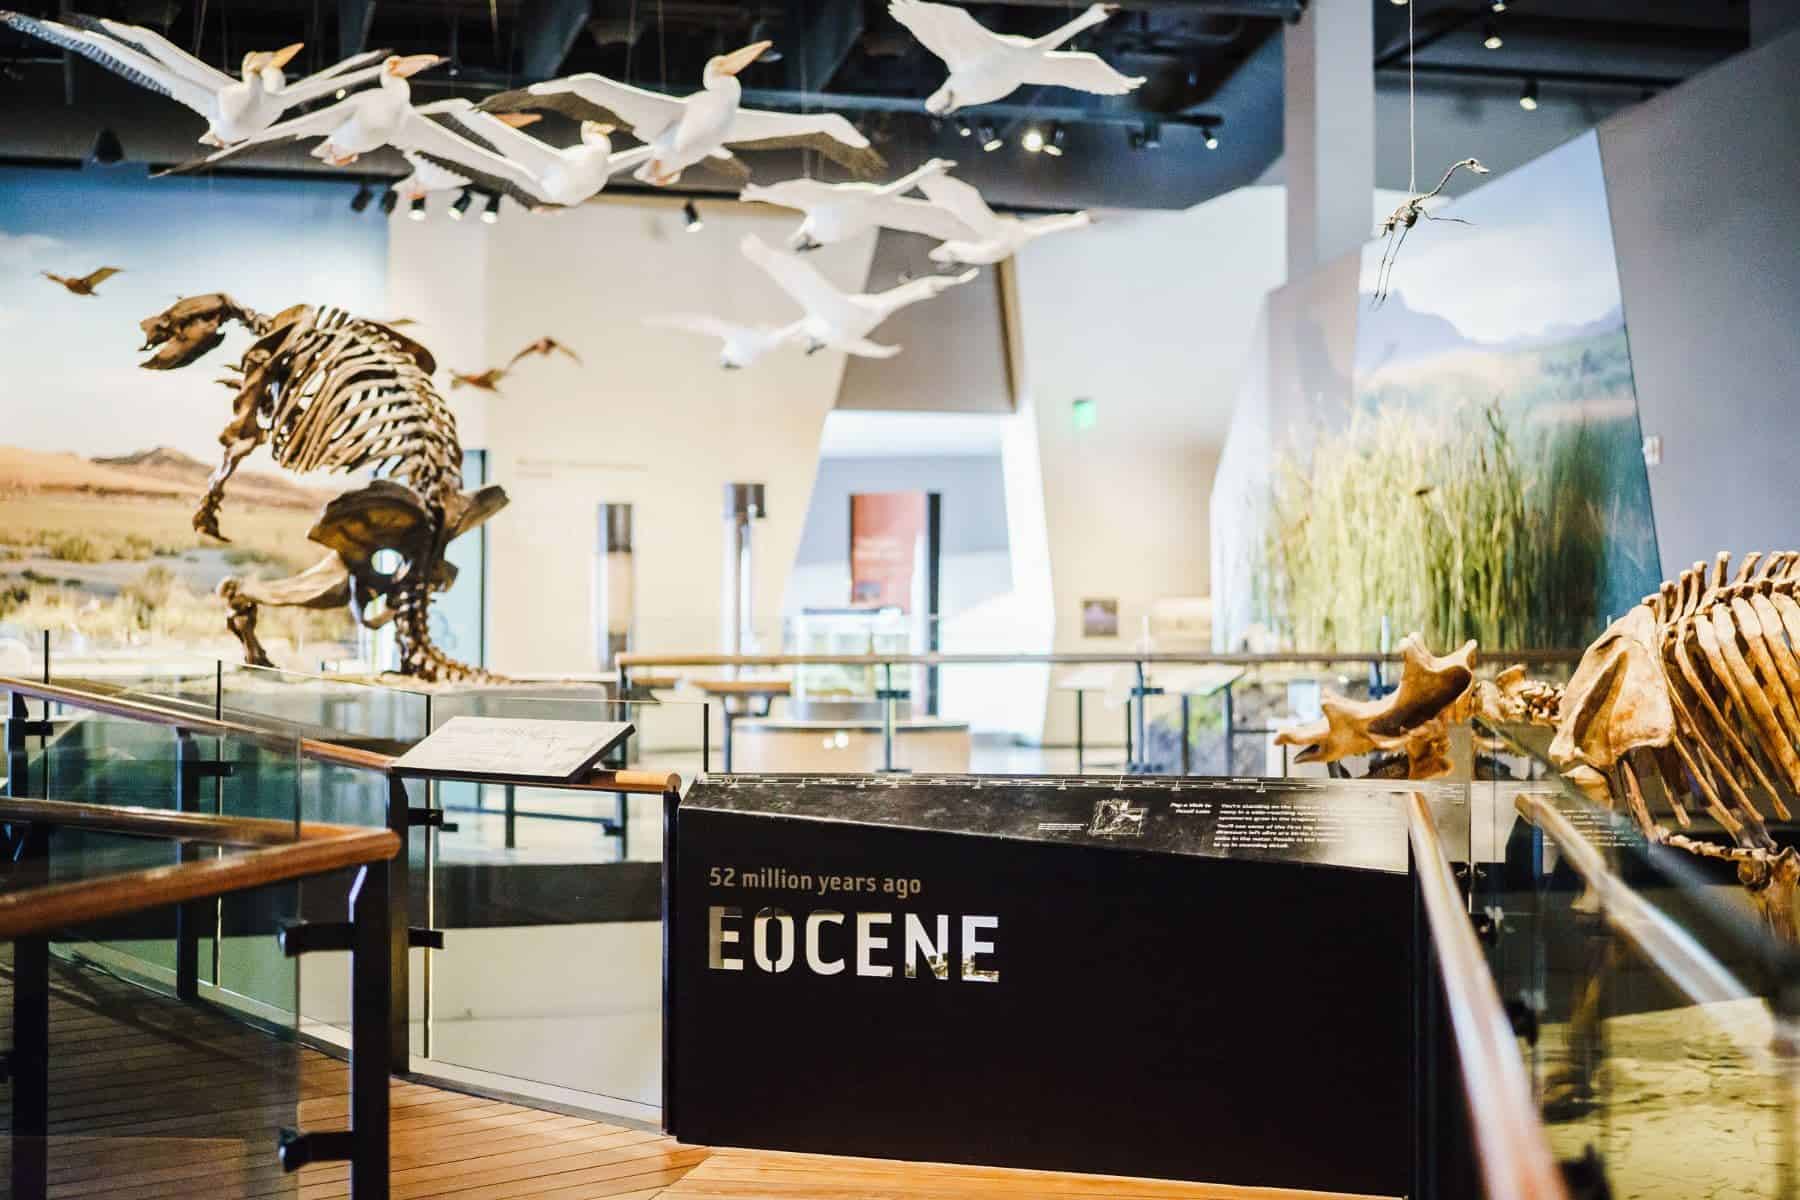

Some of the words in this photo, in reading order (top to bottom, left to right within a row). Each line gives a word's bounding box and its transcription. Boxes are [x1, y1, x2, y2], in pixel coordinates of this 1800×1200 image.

[709, 867, 735, 887] 52
[742, 868, 812, 890] million
[818, 876, 876, 896] years
[883, 878, 921, 899] ago
[708, 905, 1000, 983] EOCENE
